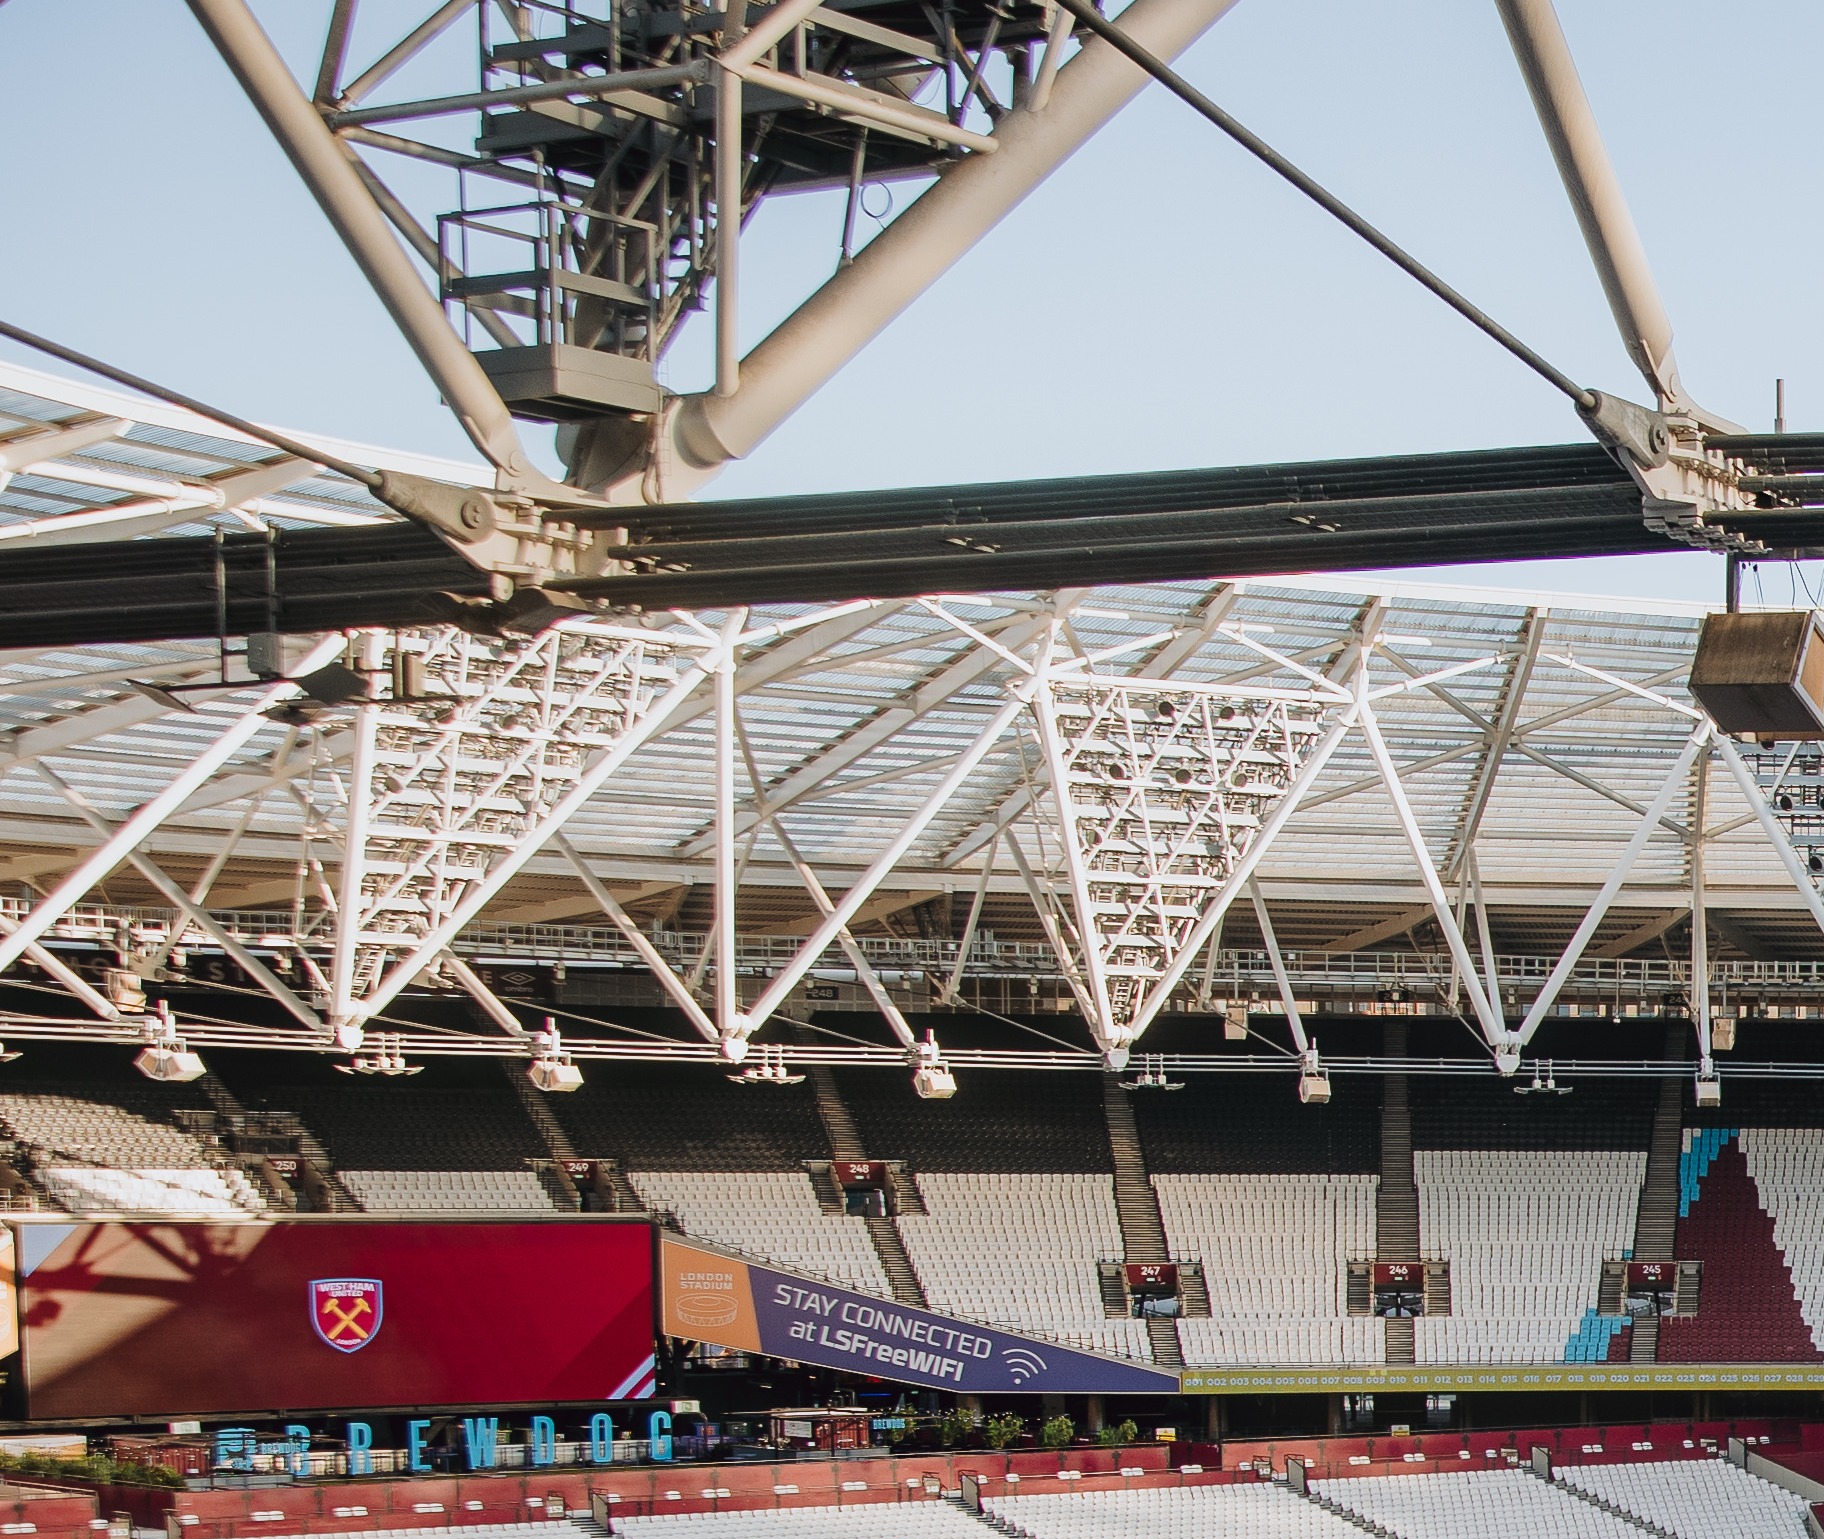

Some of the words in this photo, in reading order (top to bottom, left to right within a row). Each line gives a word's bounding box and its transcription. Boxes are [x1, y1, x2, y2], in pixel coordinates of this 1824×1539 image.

[274, 1161, 296, 1170] 250
[568, 1163, 588, 1171] 249
[850, 1164, 869, 1173] 248
[1141, 1266, 1160, 1275] 247
[1389, 1266, 1408, 1274] 246
[1643, 1265, 1661, 1273] 245
[680, 1272, 733, 1282] LONDON
[680, 1282, 733, 1290] STADIUM
[774, 1283, 839, 1317] STAY
[842, 1303, 992, 1360] CONNECTED
[789, 1319, 816, 1341] at
[287, 1411, 673, 1477] BREWDOG
